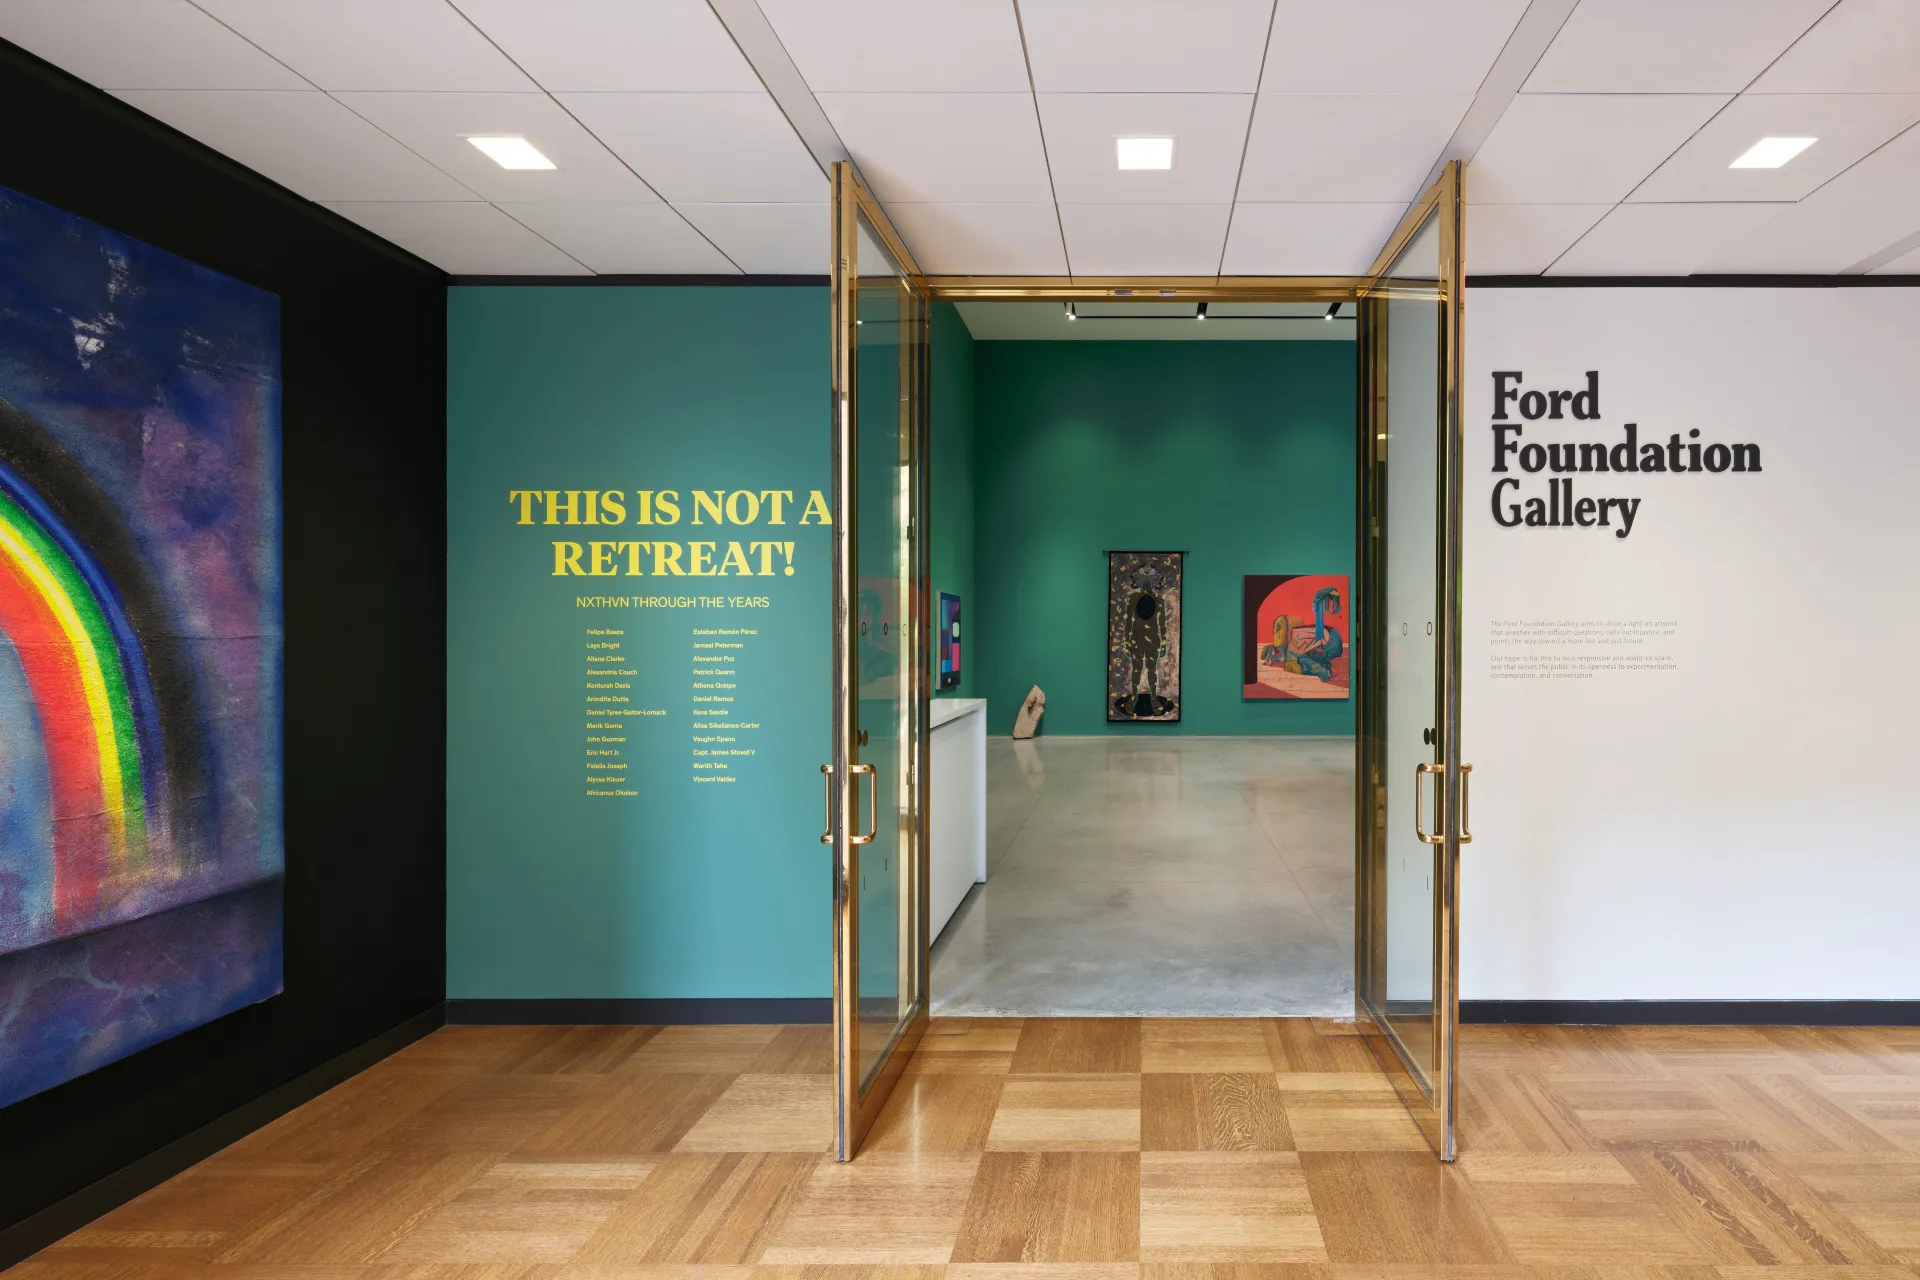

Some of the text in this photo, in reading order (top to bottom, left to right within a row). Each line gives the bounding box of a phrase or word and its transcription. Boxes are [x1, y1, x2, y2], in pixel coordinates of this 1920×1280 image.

[1491, 370, 1601, 420] Ford
[1491, 423, 1763, 473] Foundation
[509, 489, 832, 526] THIS IS NOT A
[1491, 478, 1641, 538] Gallery
[551, 541, 795, 577] RETREAT!
[576, 596, 770, 609] NXTHVN THROUGH THE YEARS
